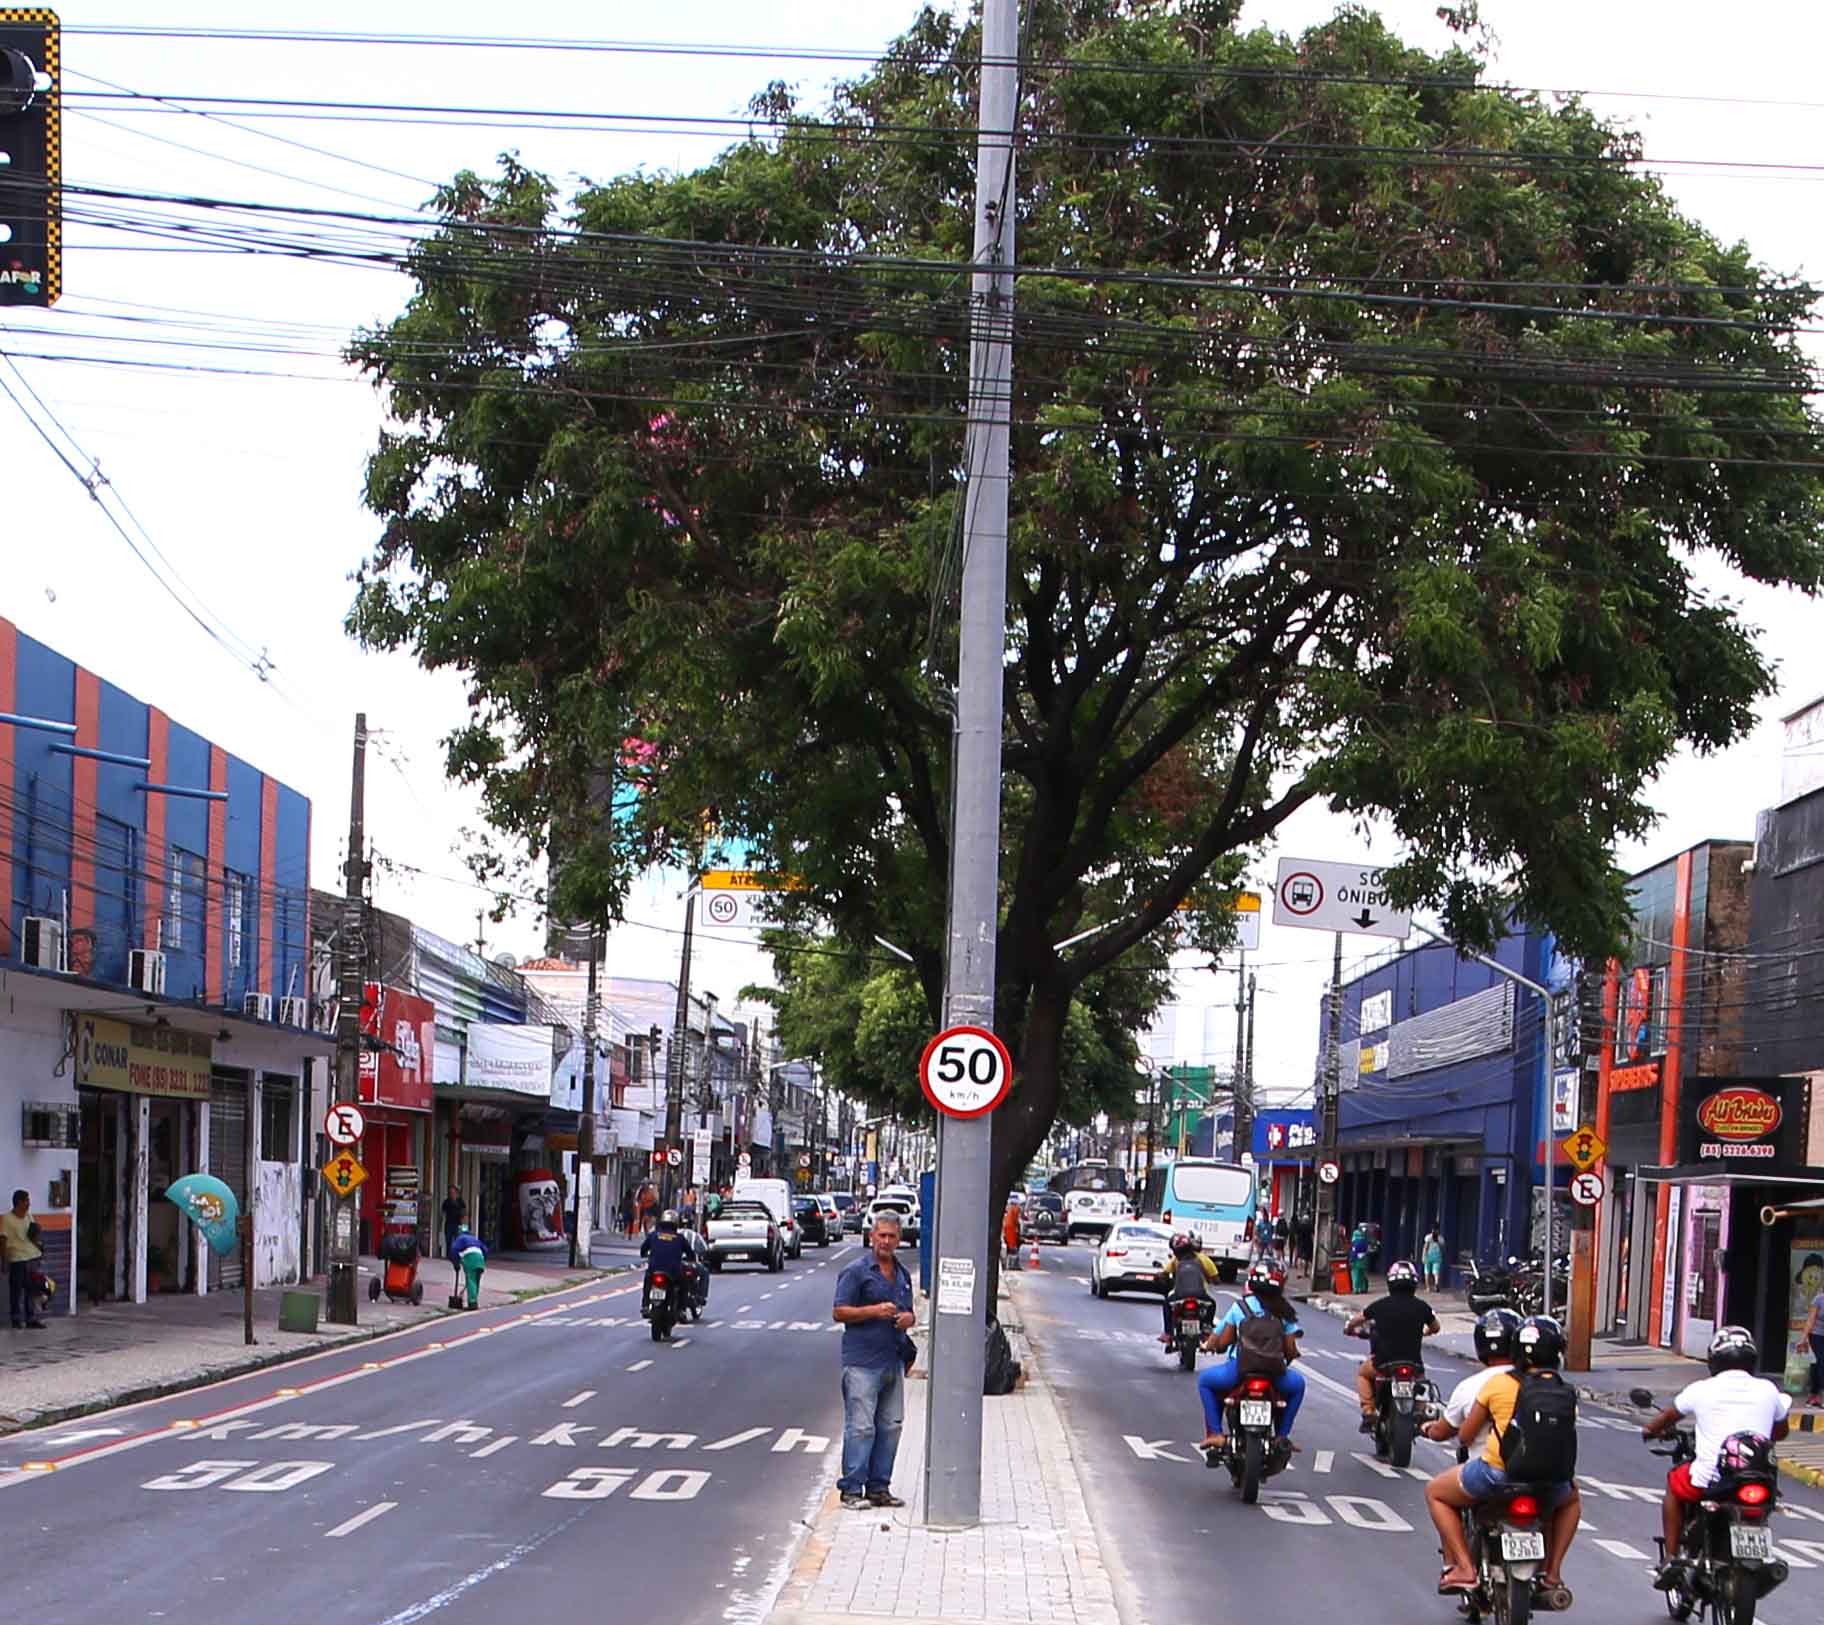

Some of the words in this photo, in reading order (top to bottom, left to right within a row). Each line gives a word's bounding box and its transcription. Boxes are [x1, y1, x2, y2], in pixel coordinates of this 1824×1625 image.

[713, 901, 733, 913] 50
[1336, 885, 1390, 906] ÔNIBU
[937, 1046, 998, 1086] 50
[949, 1089, 980, 1101] km/h
[530, 1420, 831, 1454] km/h
[139, 1460, 335, 1493] 50
[541, 1467, 712, 1501] 50
